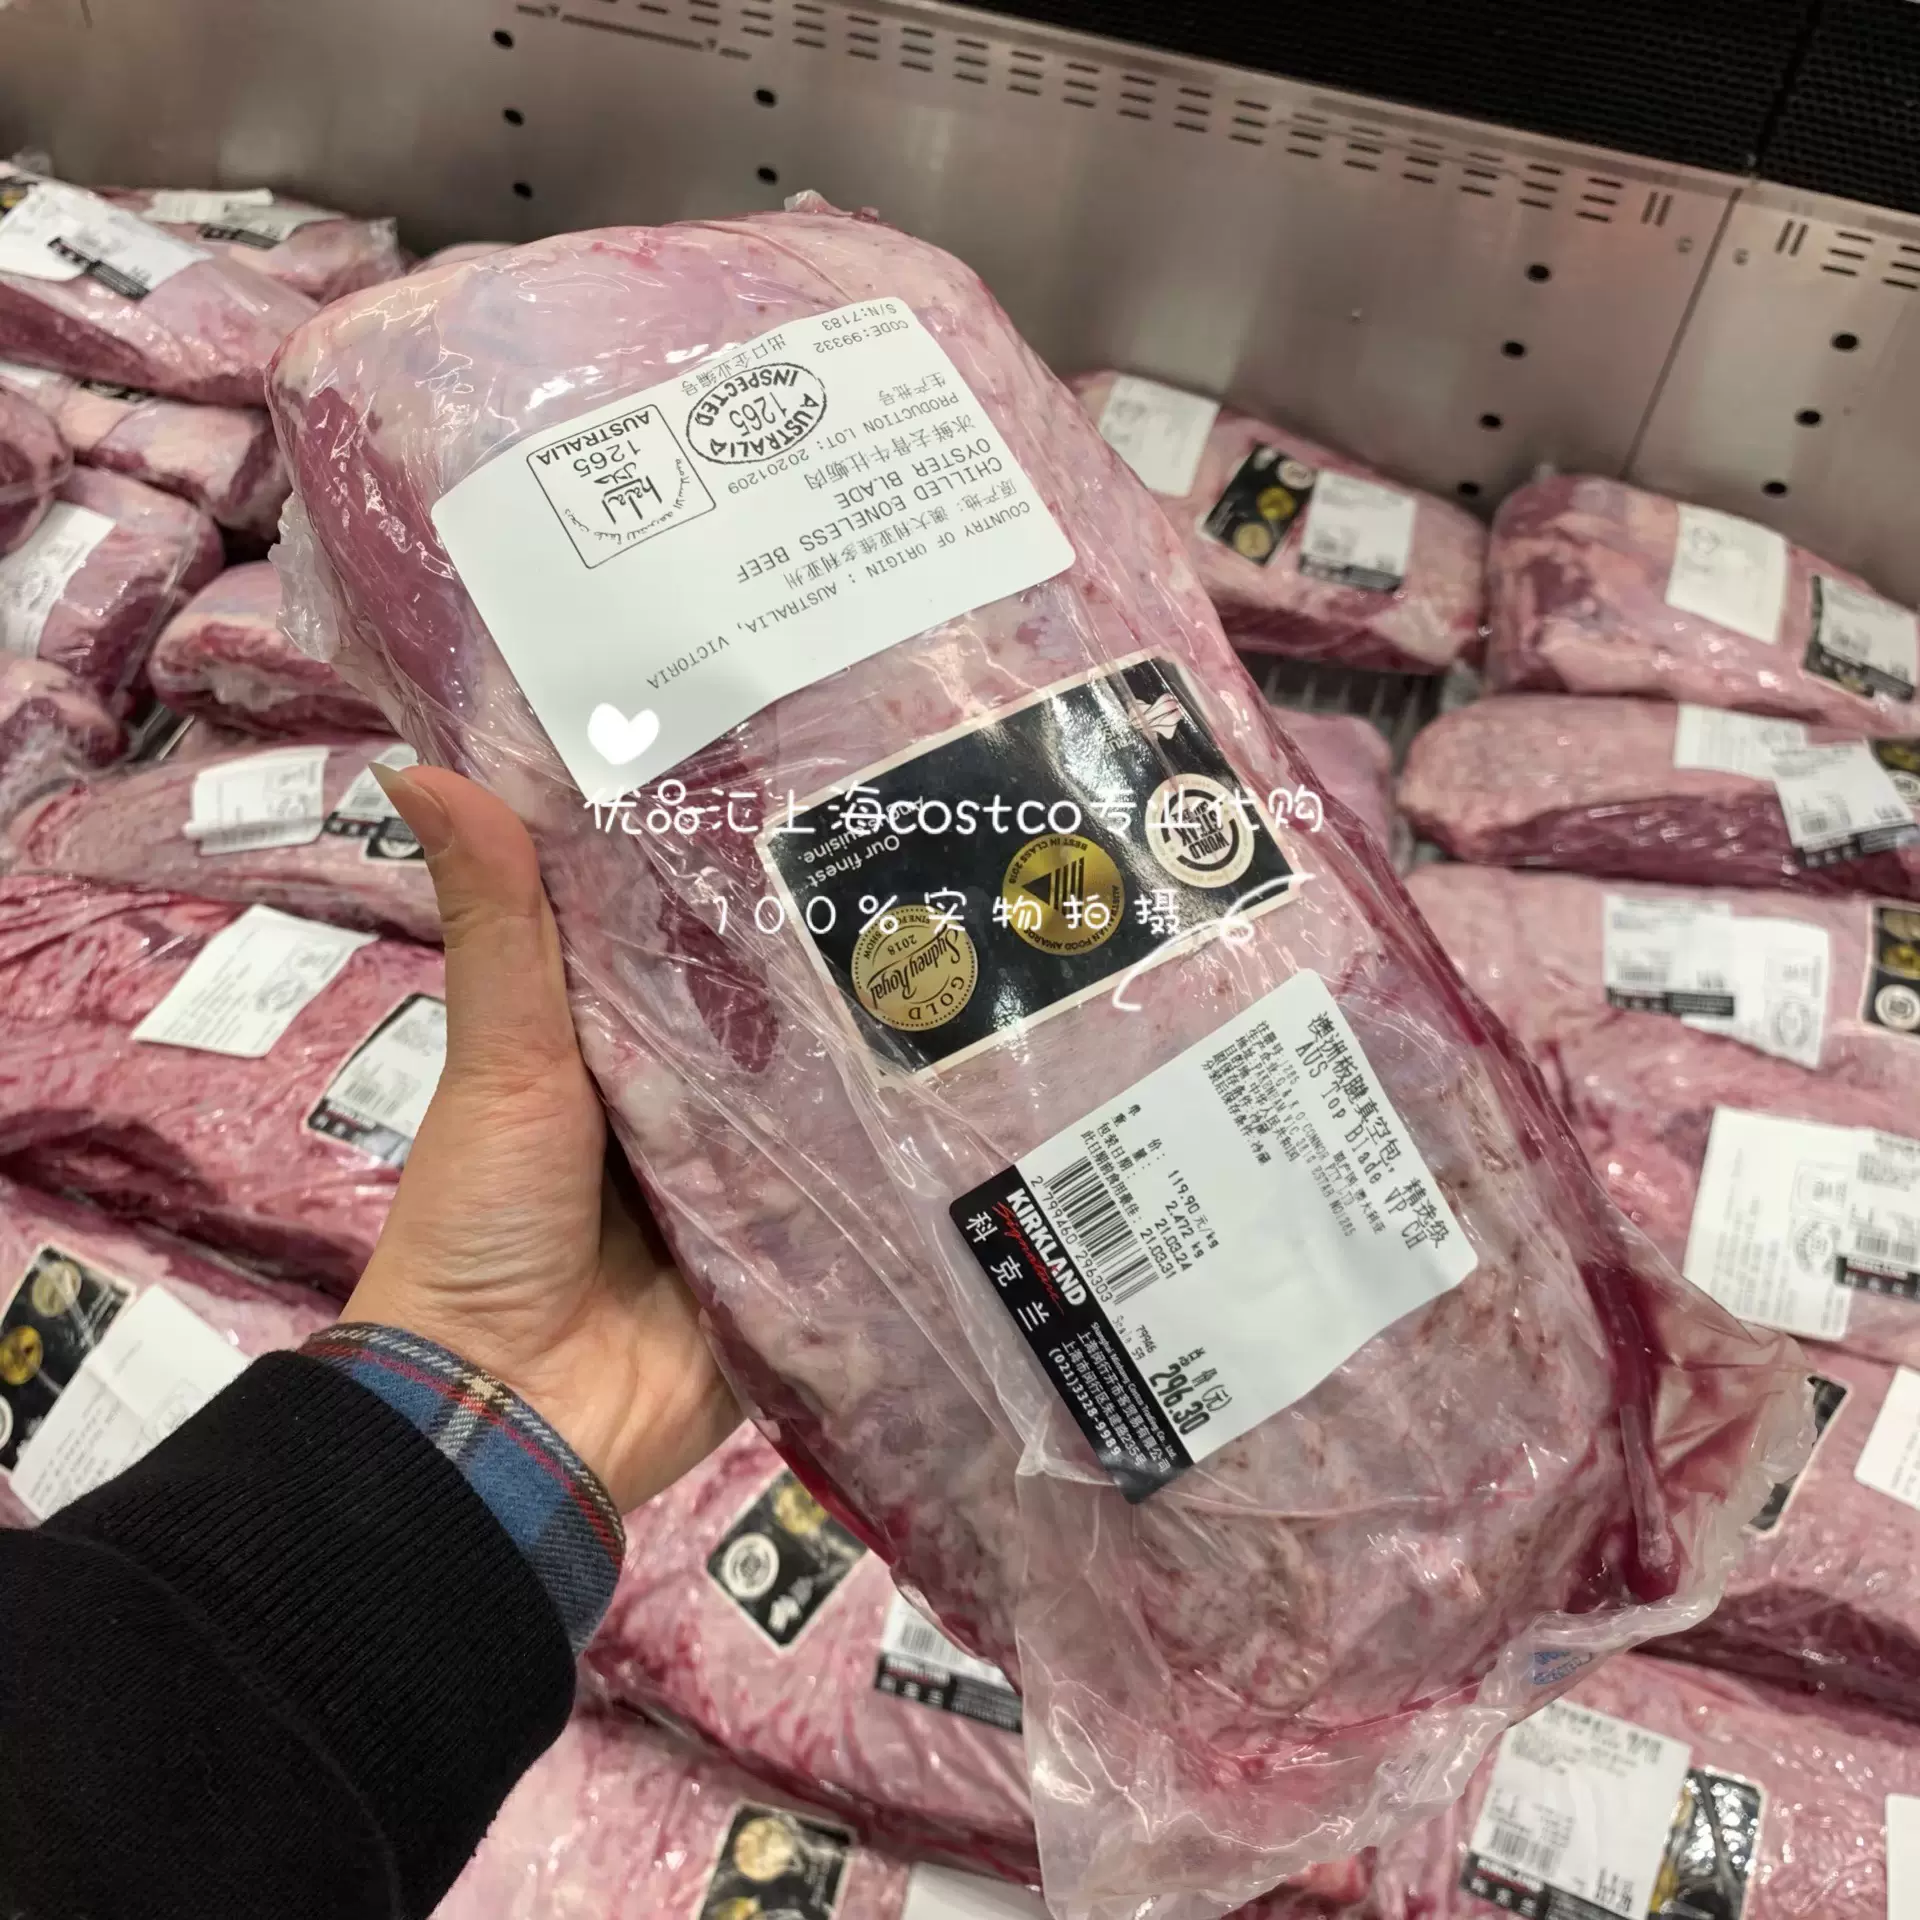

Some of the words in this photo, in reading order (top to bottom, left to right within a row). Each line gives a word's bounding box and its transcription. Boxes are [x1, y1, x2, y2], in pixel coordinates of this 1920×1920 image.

[812, 320, 909, 354] CODE:99332
[821, 303, 897, 331] S/N:7183
[681, 333, 786, 396] 出口企业编号
[694, 367, 799, 427] INSPECTED
[878, 371, 946, 406] 生产批号
[709, 393, 819, 458] AUSTRALIA
[728, 391, 787, 437] 1265
[862, 391, 959, 433] PRODUCTION
[535, 410, 650, 466] AUSTRALIA
[573, 439, 641, 478] 1265
[816, 427, 857, 450] LOT:
[911, 438, 991, 477] OYSTER
[593, 461, 637, 485] حلال
[727, 448, 810, 494] 20201209
[833, 470, 904, 509] BLADE
[913, 456, 1003, 501] CHILLED
[601, 475, 663, 525] halal
[963, 501, 1030, 537] COUNTRY
[865, 543, 927, 578] ORIGIN
[937, 531, 956, 548] OF
[737, 546, 790, 583] BEEF
[737, 581, 837, 633] AUSTRALIA,
[646, 635, 730, 689] VICTORIA
[860, 831, 902, 861] Our
[1017, 838, 1048, 864] CLASS
[1047, 834, 1062, 846] IN
[1062, 835, 1088, 851] BEST
[1188, 831, 1230, 860] WORLD
[804, 849, 865, 890] finest
[860, 925, 880, 959] SHOW
[886, 934, 917, 956] 2018
[902, 930, 964, 979] Sydney
[1063, 935, 1093, 952] FOOD
[866, 964, 917, 1010] Royal
[907, 976, 964, 1020] GOLD
[1295, 1041, 1329, 1078] AUS
[1321, 1080, 1346, 1119] Top
[1344, 1123, 1385, 1184] Blade
[1384, 1186, 1407, 1214] VP
[1401, 1219, 1428, 1250] CH
[1168, 1169, 1200, 1215] 119.90
[1324, 1162, 1343, 1182] PTY
[1006, 1186, 1087, 1305] KIRKLAND
[1030, 1175, 1044, 1188] 2
[1042, 1191, 1078, 1245] 799460
[1074, 1249, 1113, 1303] 296303
[1154, 1218, 1193, 1271] 21.03.24
[1165, 1200, 1195, 1239] 2.472
[1191, 1241, 1204, 1259] kg
[965, 1211, 1050, 1332] 科克兰
[988, 1196, 1069, 1317] Signature
[1139, 1227, 1177, 1279] 21.03.31
[1135, 1324, 1157, 1354] 79946
[1090, 1321, 1114, 1354] Shanghai
[1109, 1353, 1131, 1385] Minhang
[1127, 1382, 1144, 1406] Costco
[1141, 1404, 1160, 1432] Trading
[1148, 1362, 1210, 1435] 296.30
[1045, 1345, 1123, 1458] (021)3328-9989
